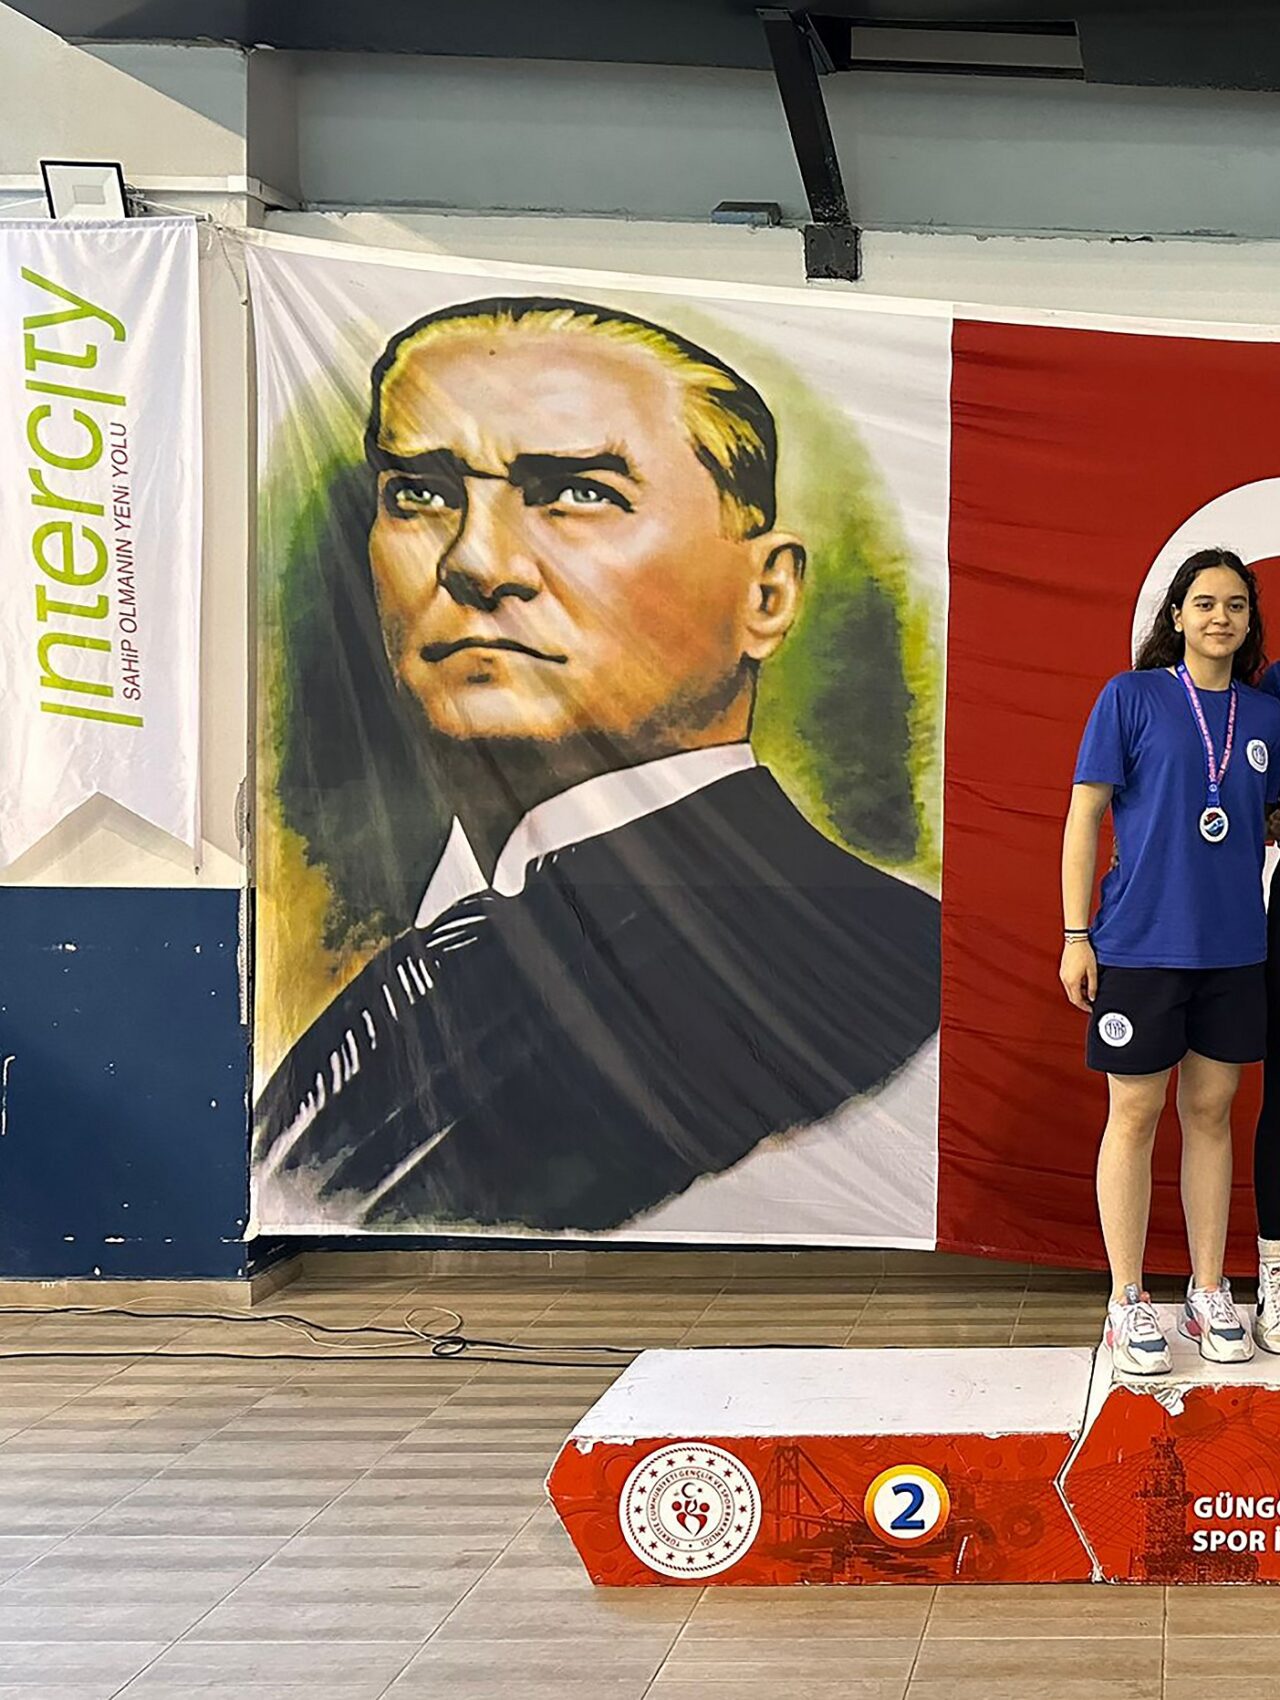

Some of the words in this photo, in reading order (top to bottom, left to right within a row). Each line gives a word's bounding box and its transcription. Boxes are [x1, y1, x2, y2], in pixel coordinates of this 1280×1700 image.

[110, 422, 129, 478] YOLU
[116, 538, 138, 634] OLMANIN
[889, 1482, 926, 1531] 2
[1192, 1530, 1266, 1553] SPOR
